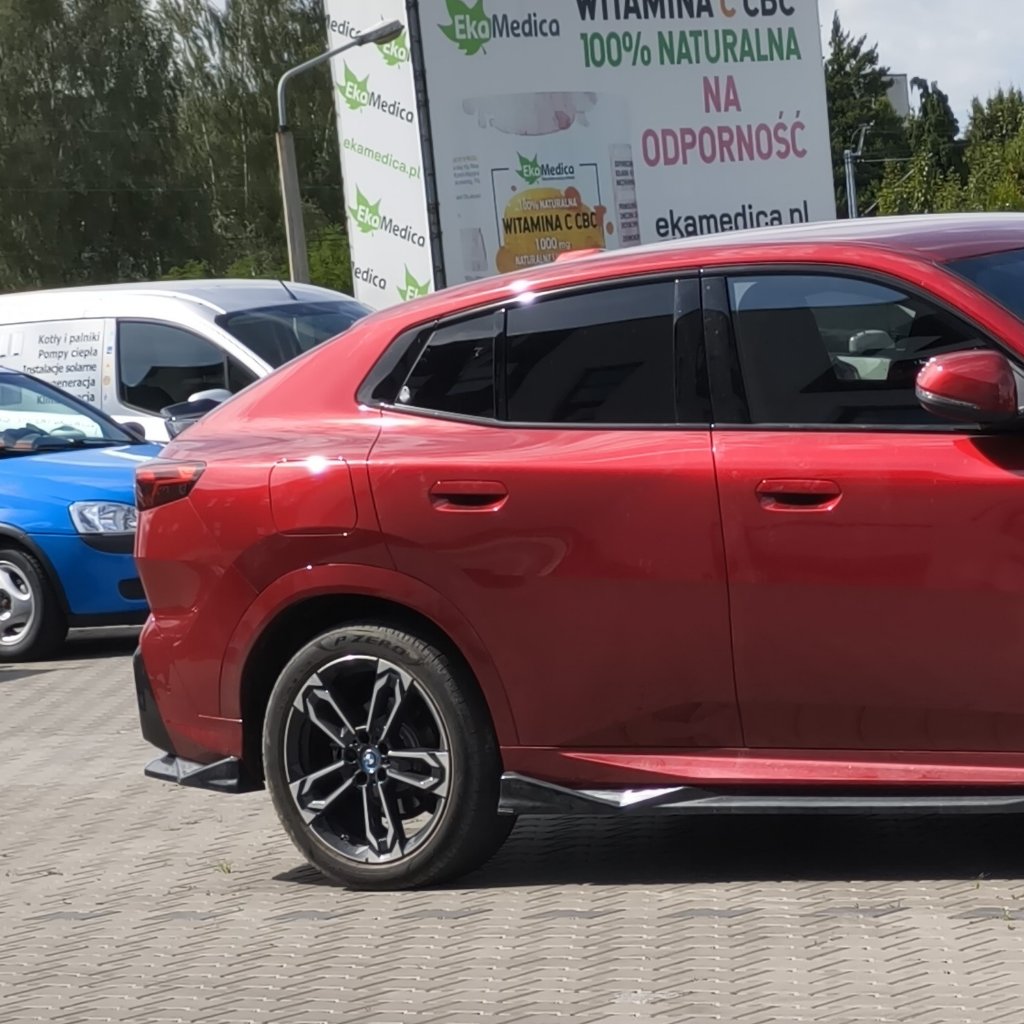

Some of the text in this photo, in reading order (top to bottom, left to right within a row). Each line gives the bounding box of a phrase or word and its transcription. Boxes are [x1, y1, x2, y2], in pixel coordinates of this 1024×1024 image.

[576, 0, 714, 21] WITAMINA
[580, 27, 802, 67] 100% NATURALNA
[703, 75, 742, 113] NA
[641, 110, 807, 167] ODPORNOŚĆ
[343, 138, 421, 179] ekamedica.pl
[502, 212, 598, 235] WITAMINA C CBC
[655, 200, 809, 238] ekamedicapl
[535, 238, 558, 250] 1000
[351, 261, 387, 290] edica
[39, 349, 68, 360] Pompy
